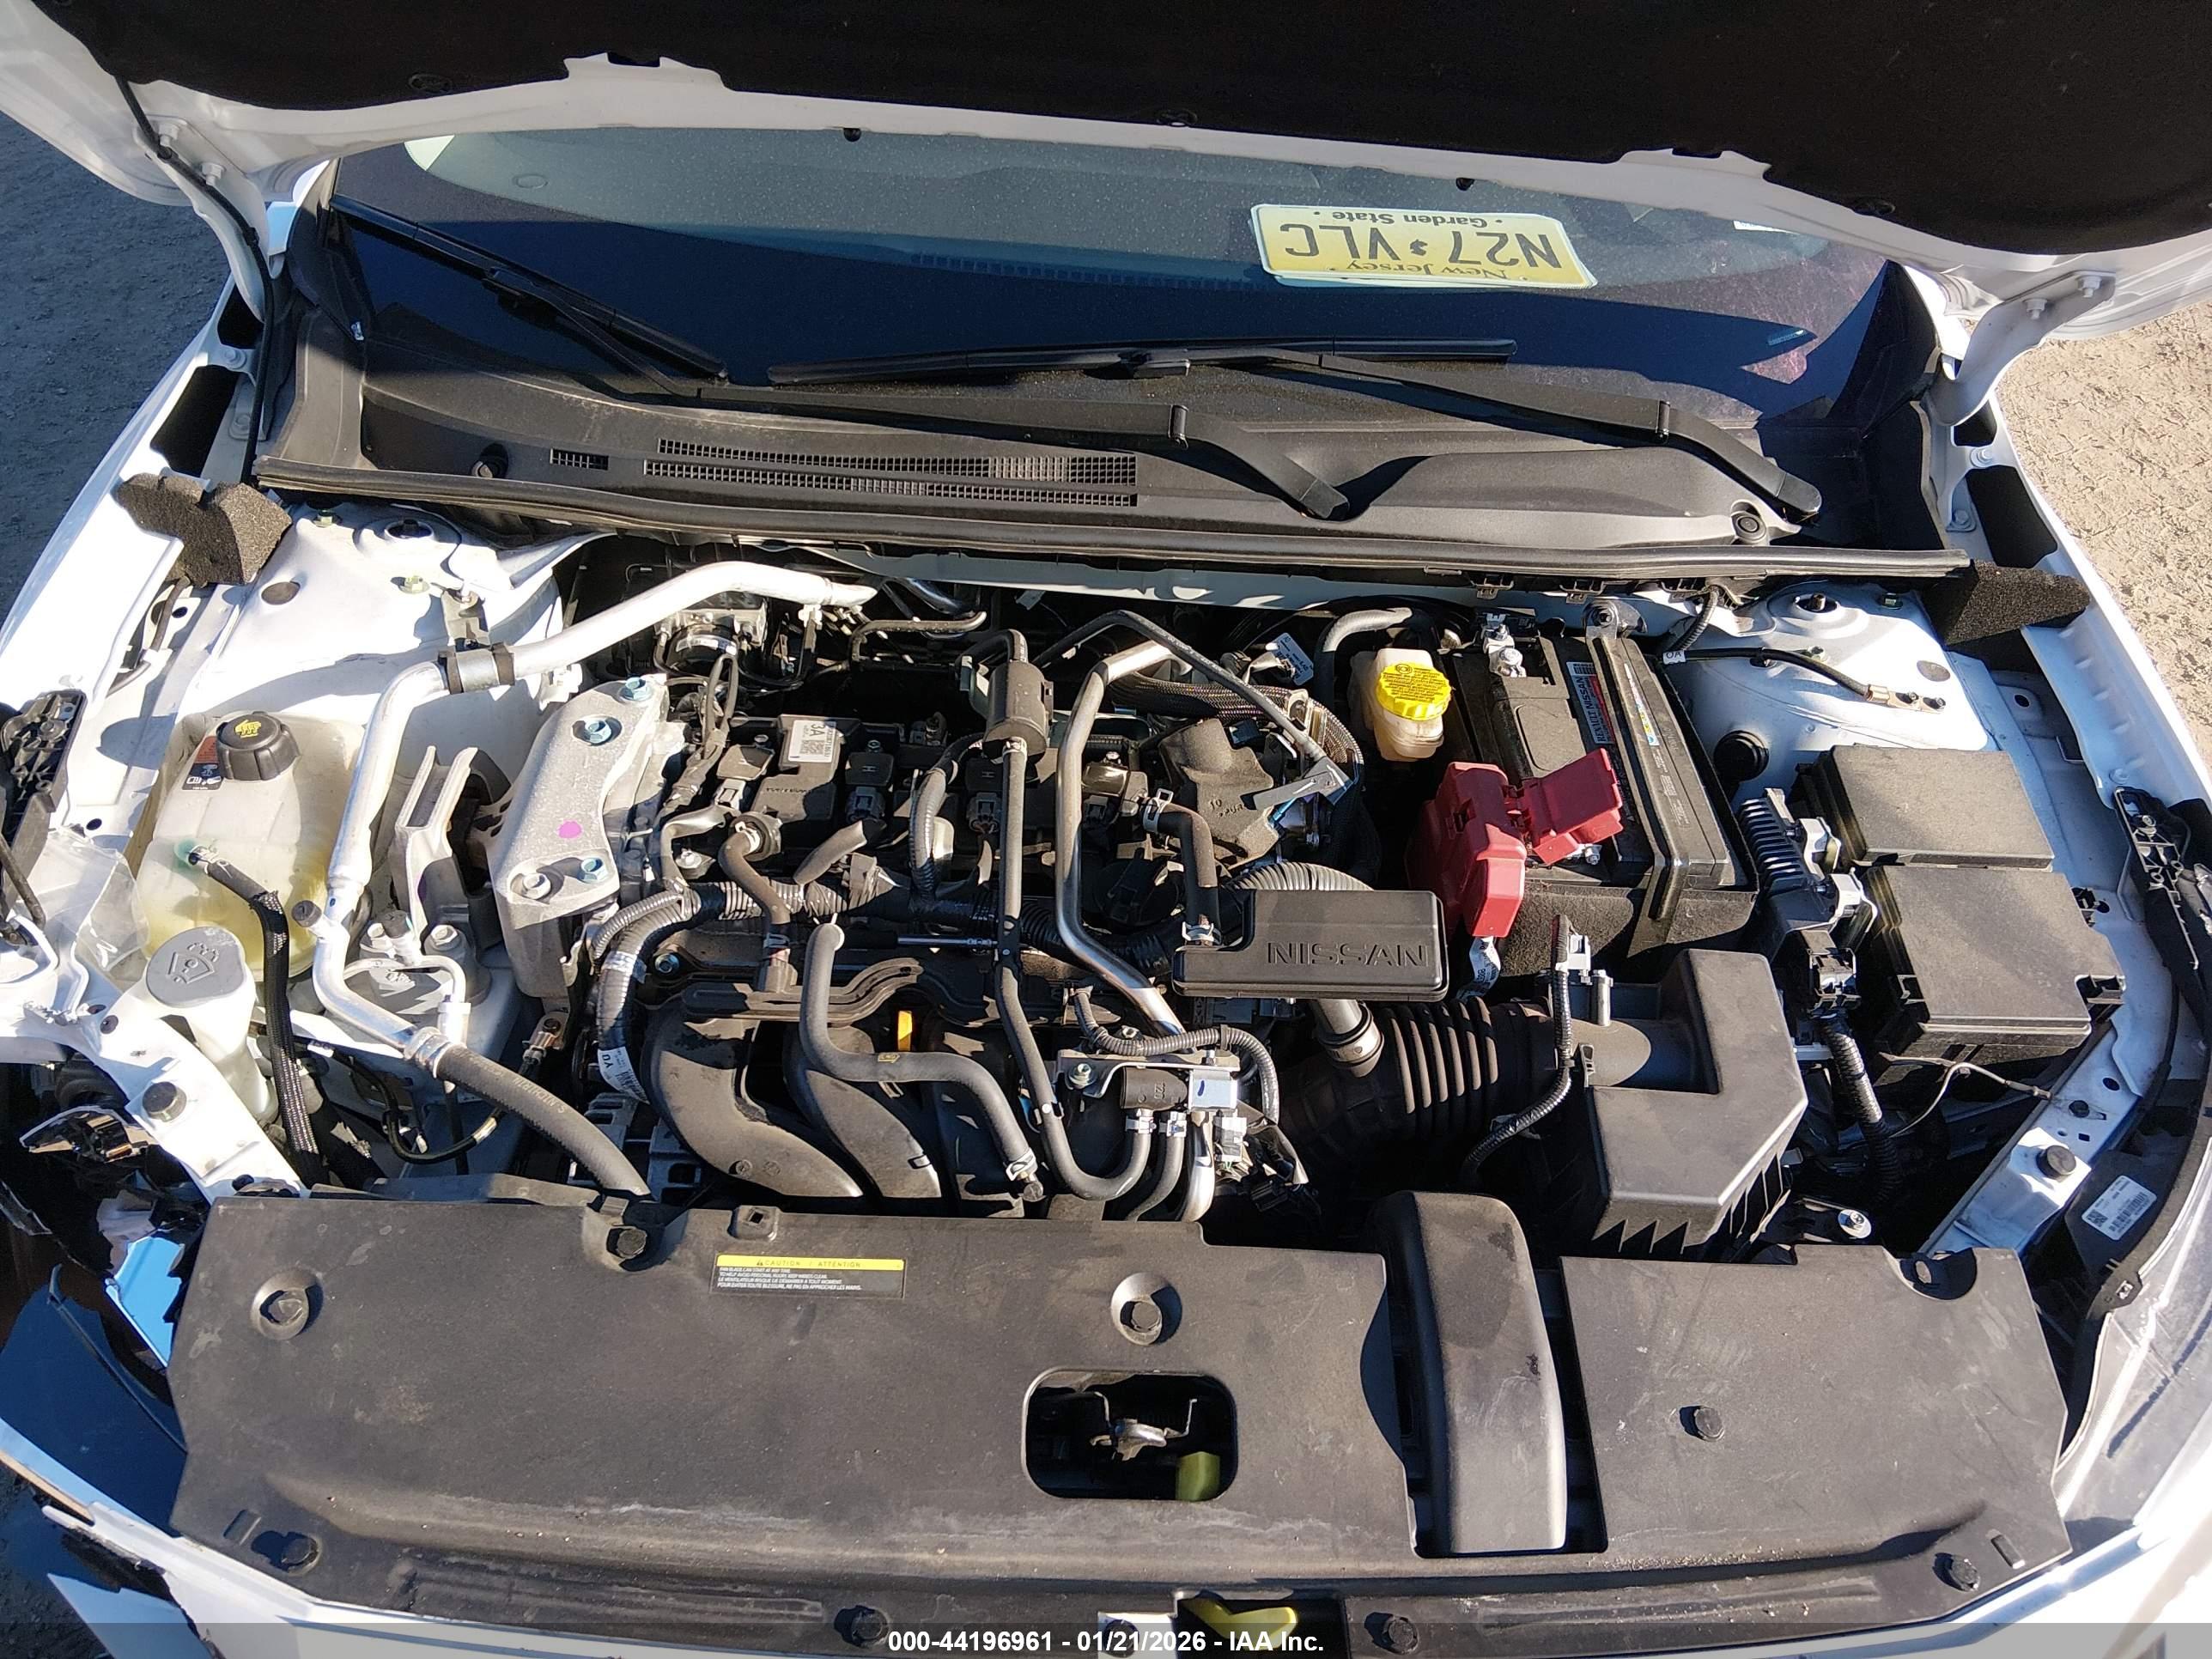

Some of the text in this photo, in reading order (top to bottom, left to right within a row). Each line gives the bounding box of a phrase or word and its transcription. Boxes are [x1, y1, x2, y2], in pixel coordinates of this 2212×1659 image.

[1331, 210, 1488, 228] Garden State
[1279, 222, 1562, 269] N27 VLC
[1346, 258, 1507, 280] New Jersey
[1575, 677, 1595, 710] NISSAN
[810, 724, 825, 737] 3A
[1267, 941, 1429, 967] NISSAN
